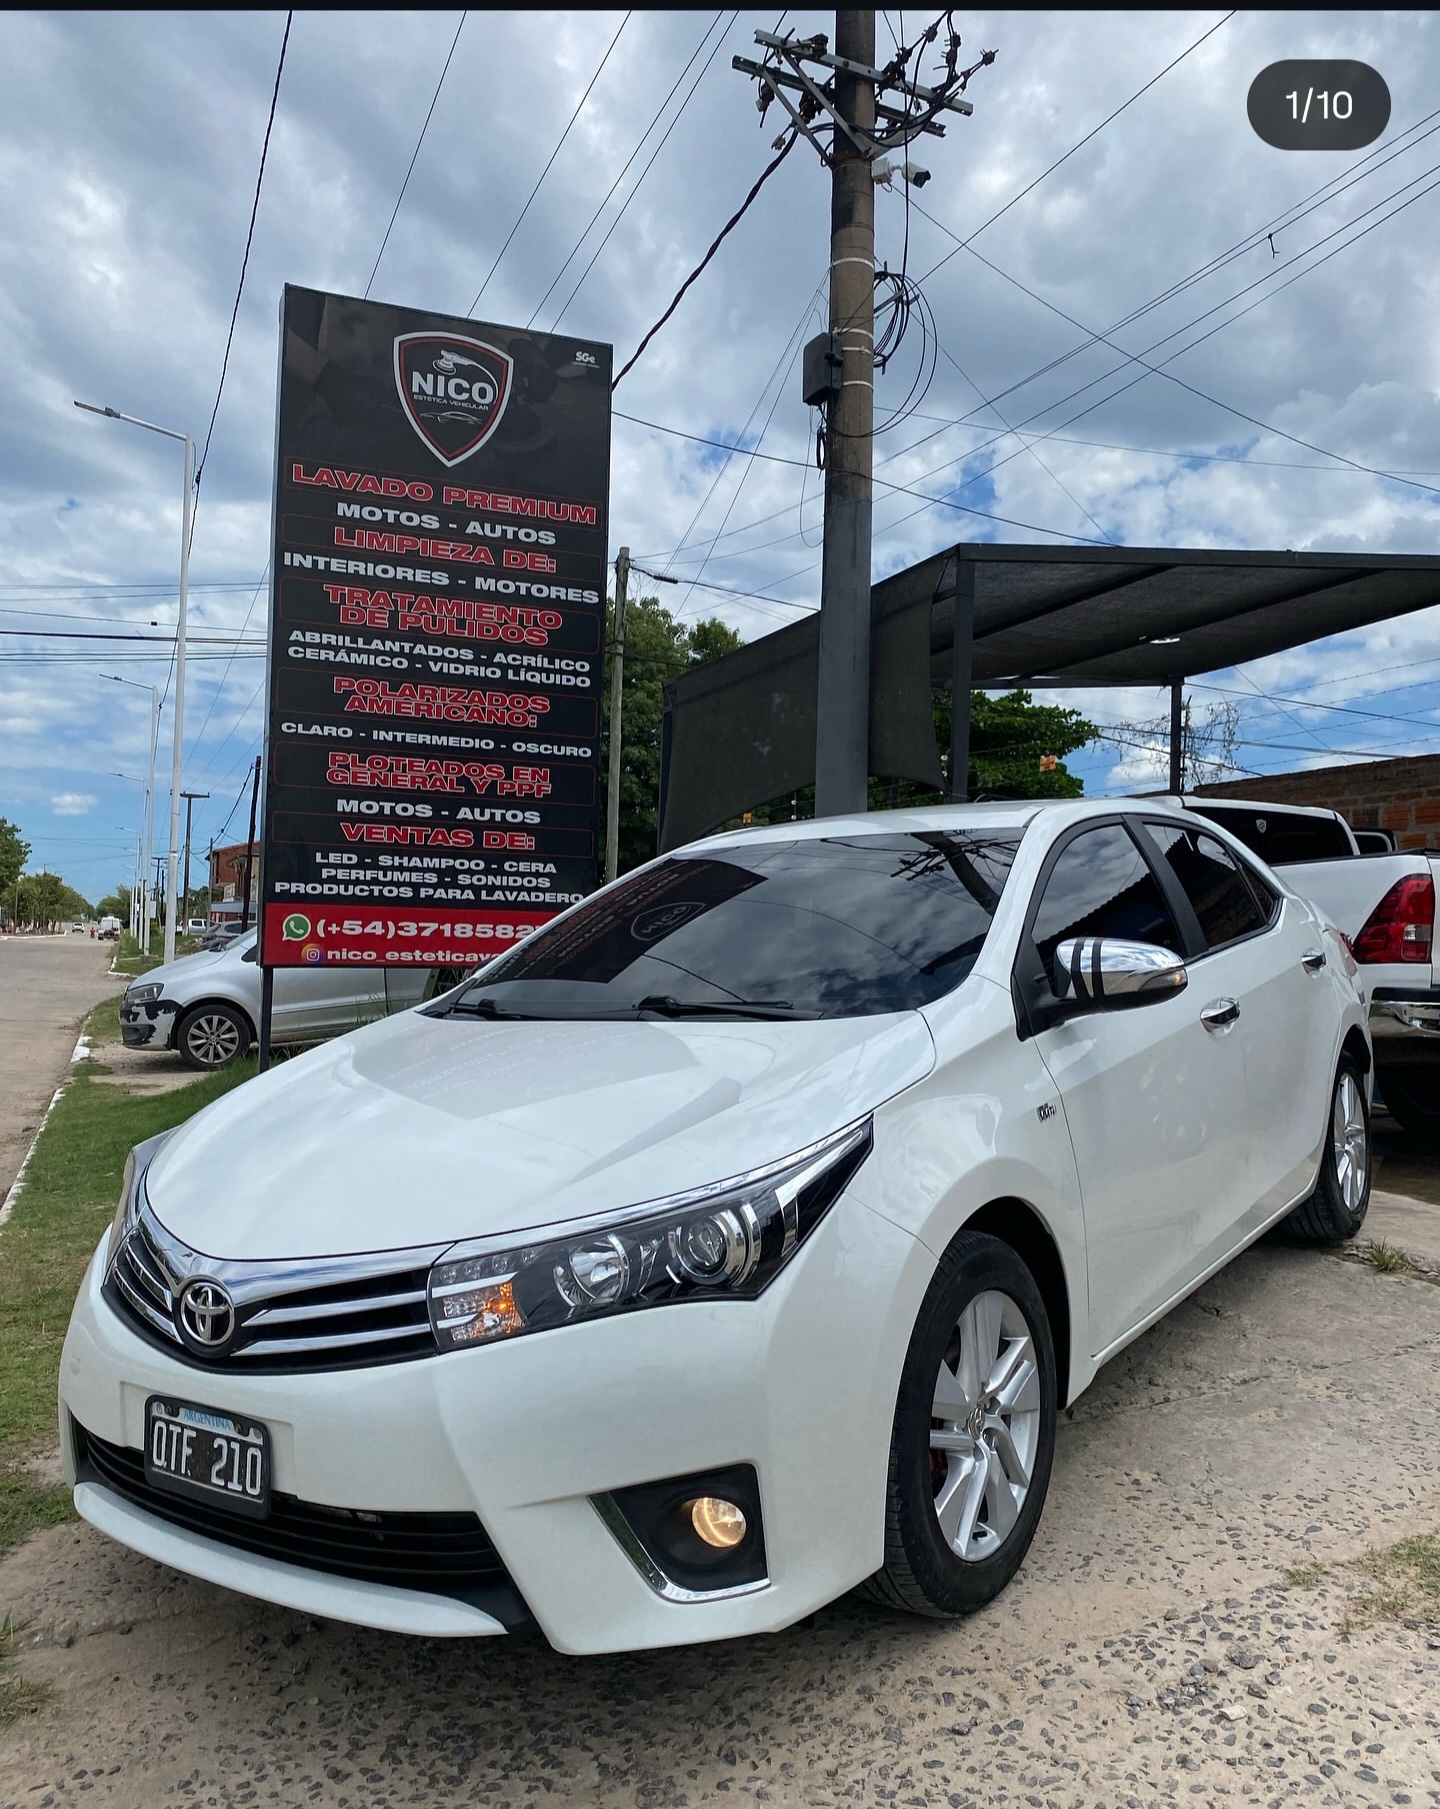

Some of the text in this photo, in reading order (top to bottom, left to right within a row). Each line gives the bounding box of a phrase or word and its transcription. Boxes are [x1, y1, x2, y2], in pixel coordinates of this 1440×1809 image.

[411, 370, 494, 404] NICO
[413, 394, 489, 411] ESTÉTICA VEHICULAR
[292, 464, 596, 525] LAVADO PREMIUM
[337, 502, 440, 529] MOTOS
[465, 521, 557, 545] AUTOS
[334, 527, 557, 573] LIMPIEZA DE:
[284, 552, 450, 586] INTERIORES
[475, 577, 599, 604] MOTORES
[323, 584, 563, 629] TRATAMIENTO
[340, 605, 548, 646] DE PULIDOS
[288, 645, 408, 669] CERÁMICO
[428, 661, 501, 679] VIDRIO
[508, 667, 591, 687] LÍQUIDO
[289, 630, 474, 661] ABRILLANTADOS
[493, 652, 590, 672] ACRÍLICO
[333, 677, 550, 713] POLARIZADOS
[344, 695, 537, 728] AMERICANO:
[282, 722, 352, 738] CLARO
[373, 729, 494, 750] INTERMEDIO
[512, 742, 591, 757] OSCURO
[327, 769, 552, 797] GENERAL Y PPF
[328, 752, 550, 783] PLOTEADOS EN
[337, 799, 433, 818] MOTOS
[456, 807, 540, 823] AUTOS
[340, 823, 535, 850] VENTAS DE:
[315, 852, 357, 864] LED
[378, 855, 485, 871] SHAMPOO
[504, 861, 556, 874] CERA
[322, 868, 438, 883] PERFUMES
[458, 874, 551, 888] SONIDOS
[275, 882, 413, 898] PRODUCTOS
[420, 887, 475, 900] PARA
[317, 919, 539, 938] (+54)3718582
[184, 1409, 230, 1430] ARGENTINA
[211, 1437, 262, 1496] 210
